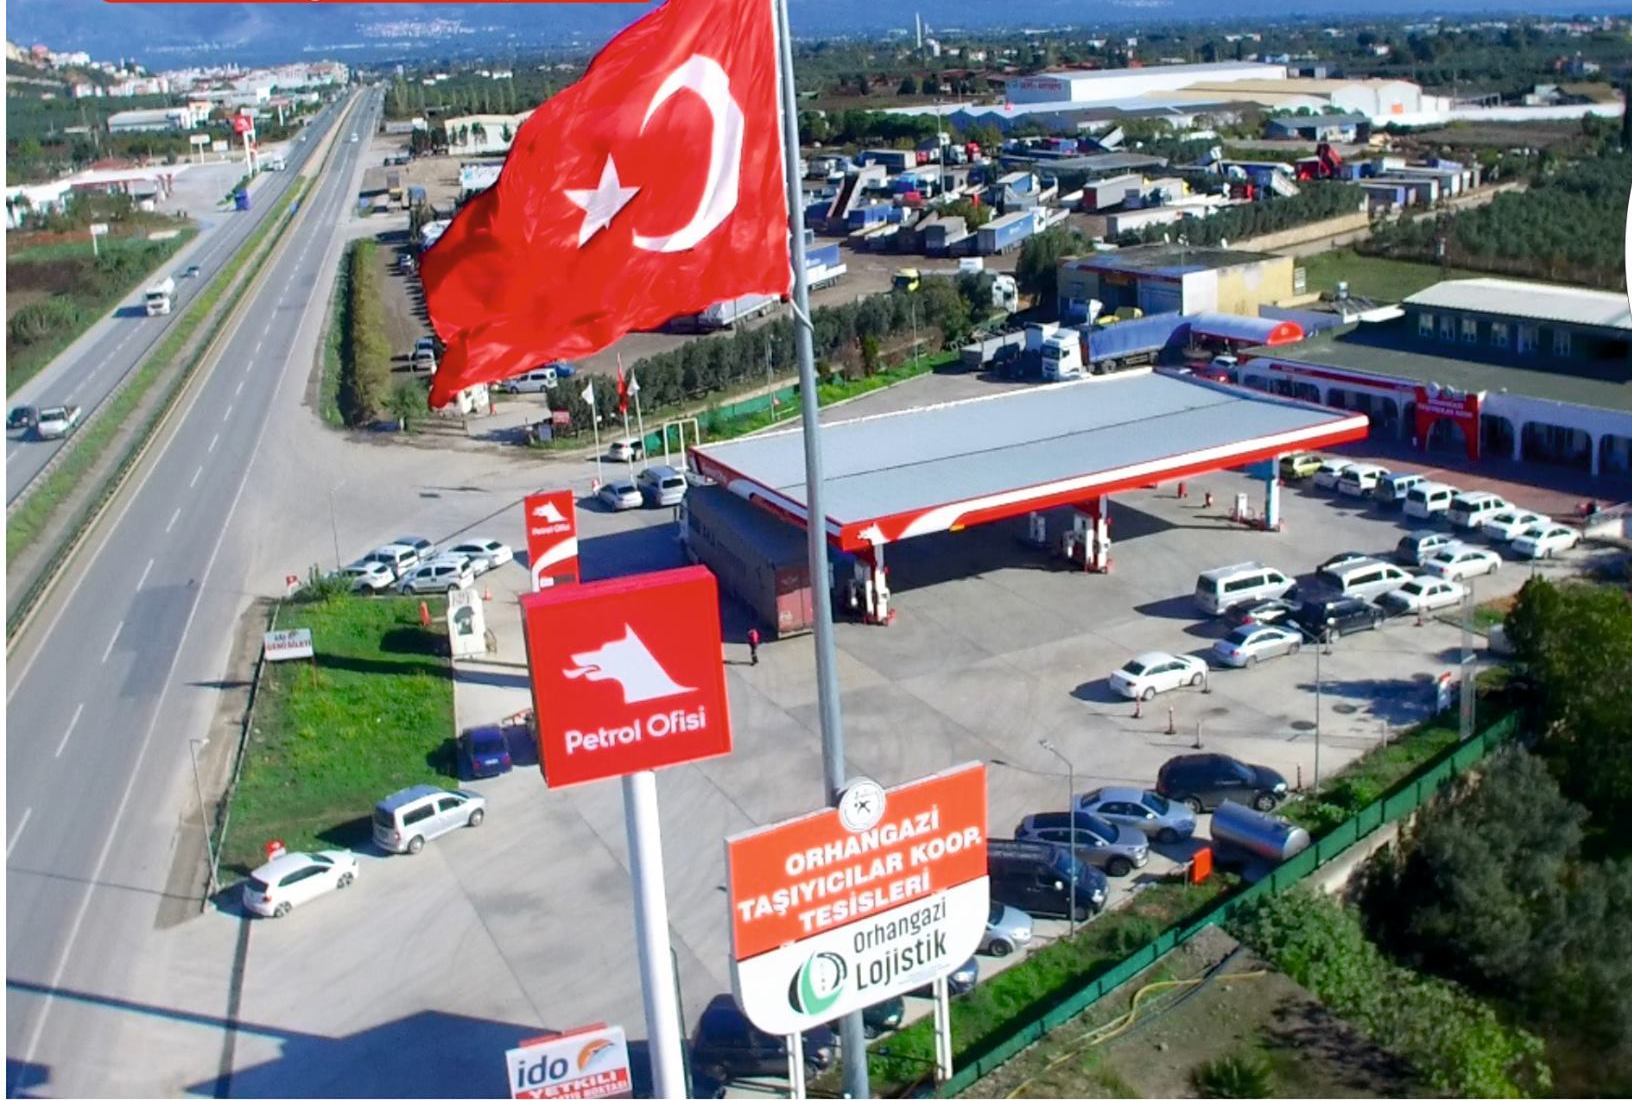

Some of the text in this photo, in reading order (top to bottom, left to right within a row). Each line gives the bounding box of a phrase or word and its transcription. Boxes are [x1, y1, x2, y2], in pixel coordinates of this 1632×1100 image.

[564, 705, 707, 755] Petrol Ofisi
[785, 804, 939, 876] ORHANGAZİ
[737, 826, 983, 922] TAŞIYICILAR KOOP.
[799, 866, 931, 932] TESİSLERİ
[853, 897, 947, 954] Orhangazi
[856, 929, 947, 991] Lojistik
[517, 1054, 569, 1088] ido
